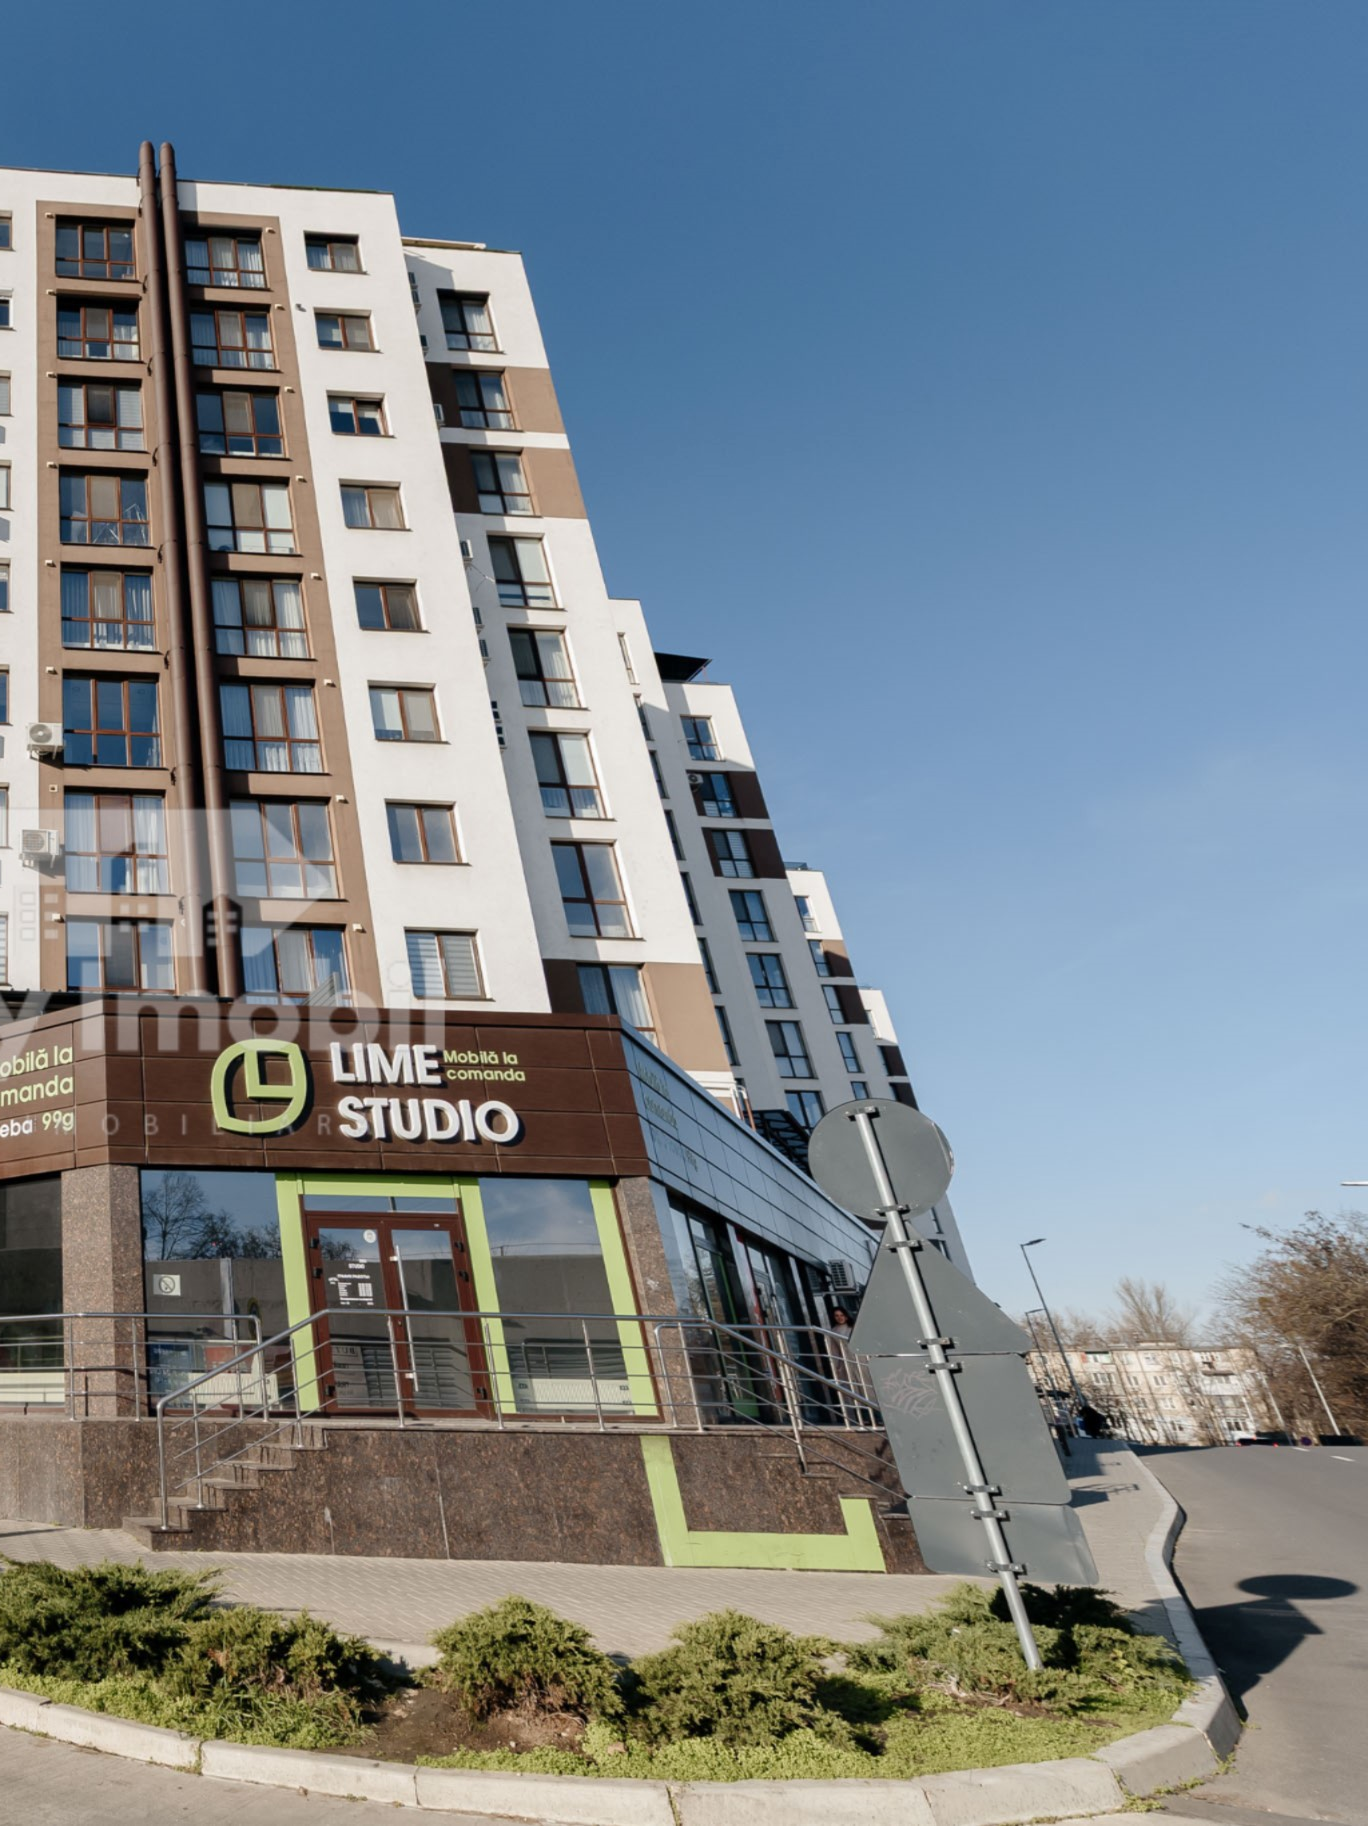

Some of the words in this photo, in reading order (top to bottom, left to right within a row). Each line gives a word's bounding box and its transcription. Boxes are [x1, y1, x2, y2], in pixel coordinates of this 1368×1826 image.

[53, 1045, 74, 1067] la
[330, 1041, 442, 1085] LIME
[443, 1050, 499, 1064] Mobilă
[503, 1051, 518, 1065] la
[446, 1067, 526, 1081] comanda
[42, 1110, 74, 1132] 99g
[337, 1095, 520, 1143] STUDIO
